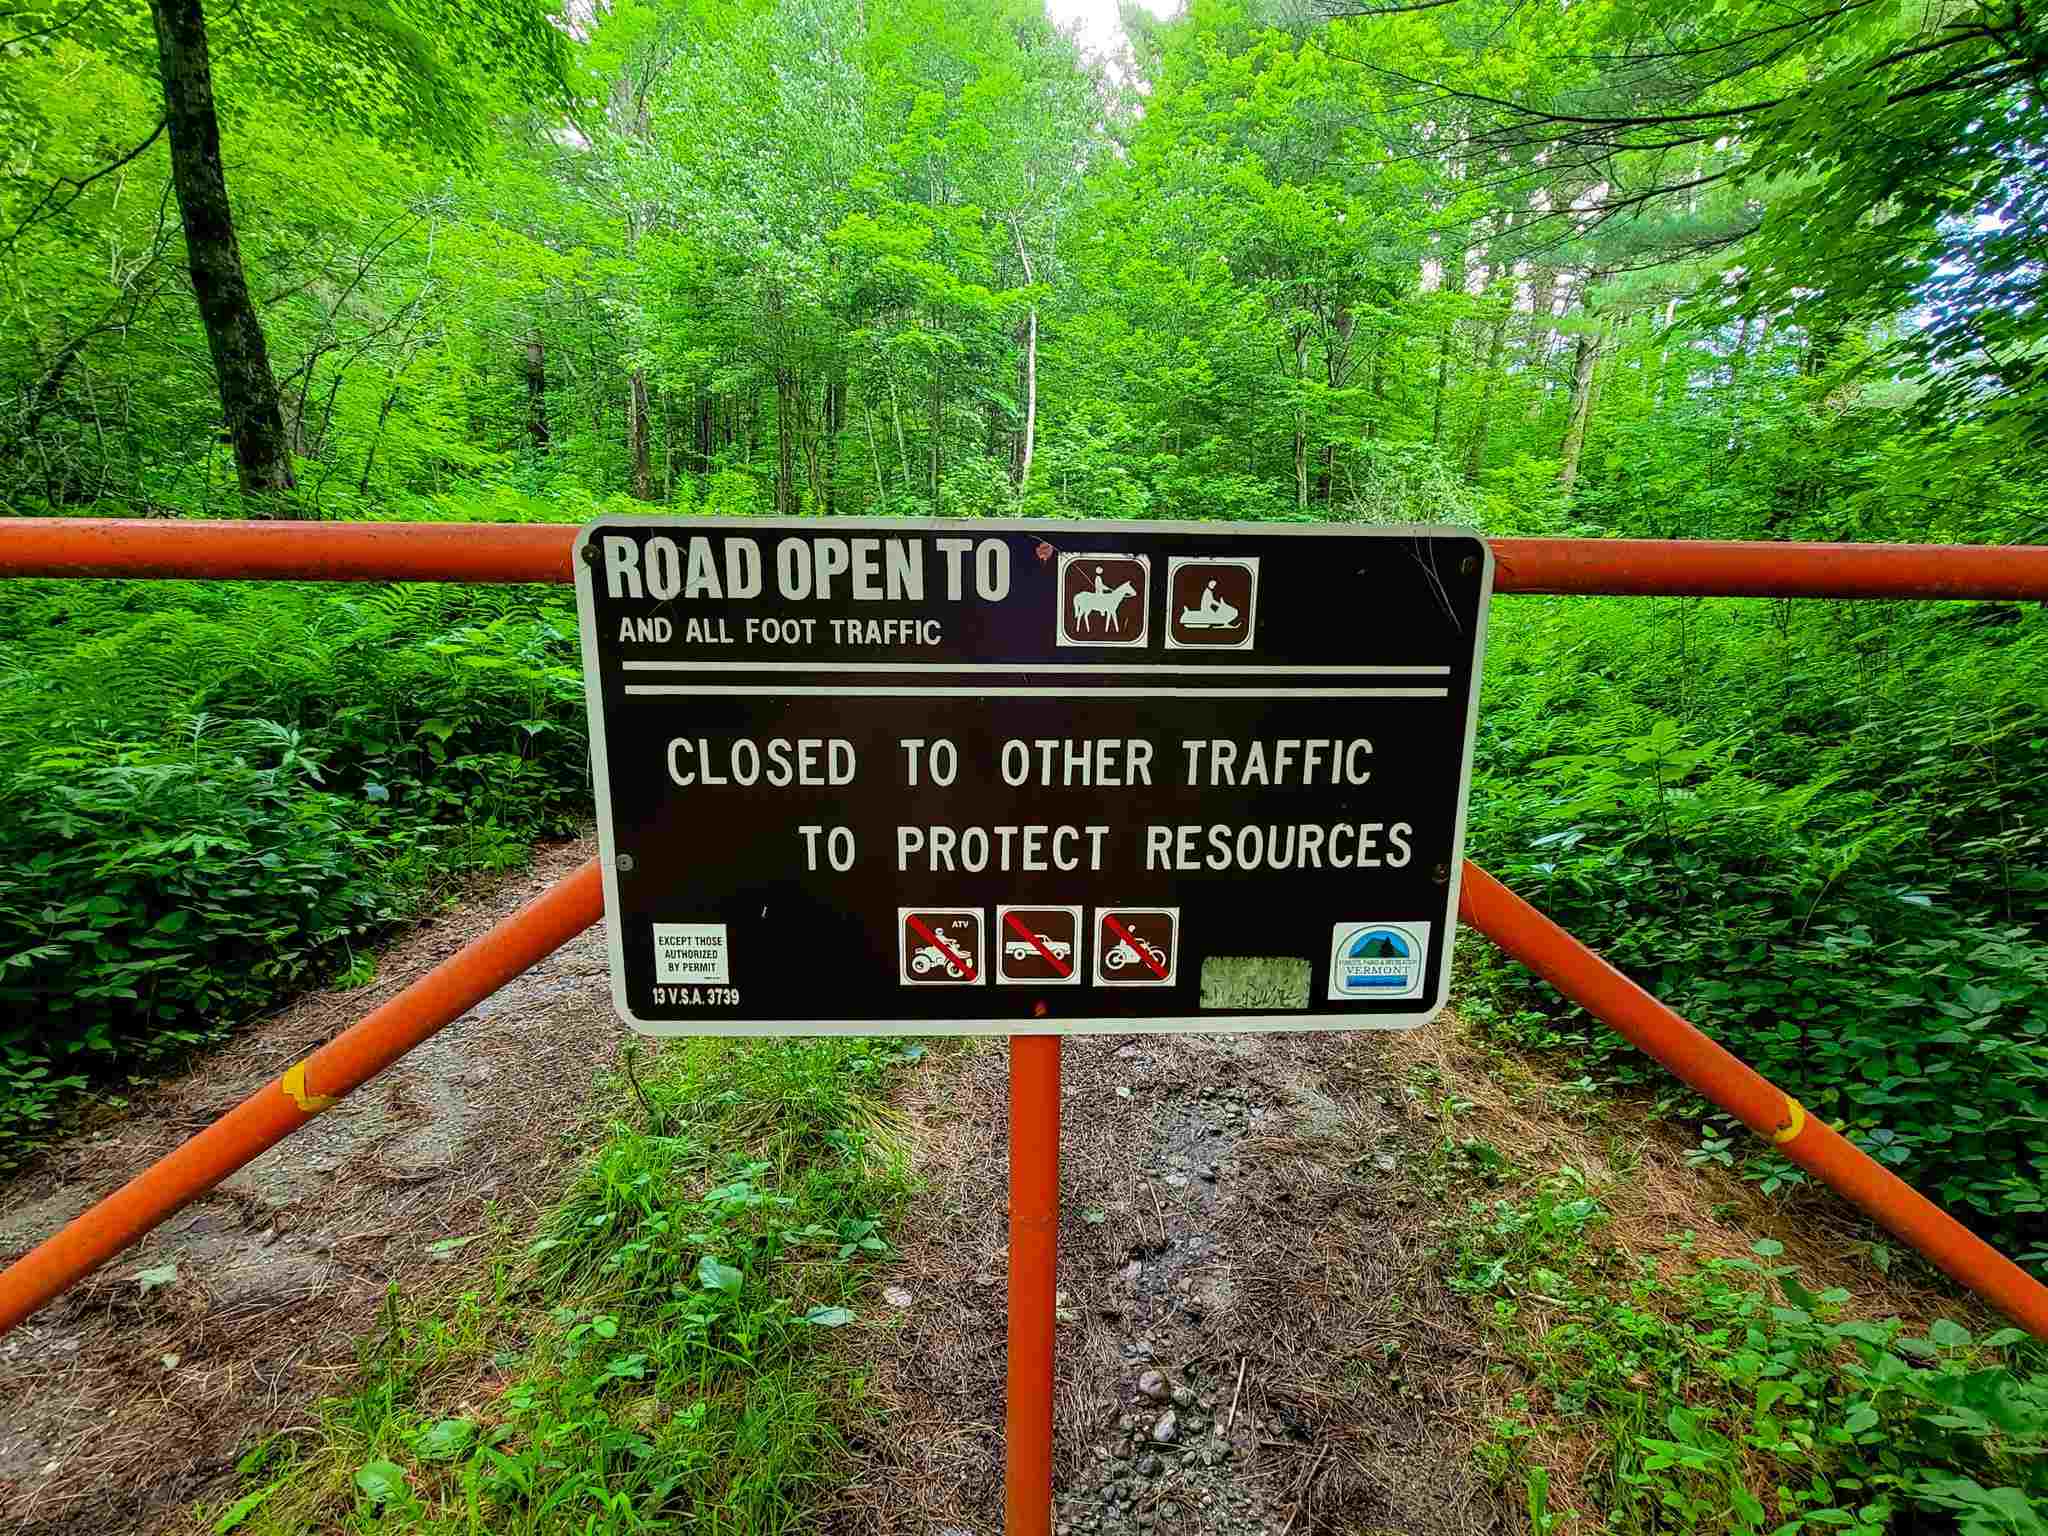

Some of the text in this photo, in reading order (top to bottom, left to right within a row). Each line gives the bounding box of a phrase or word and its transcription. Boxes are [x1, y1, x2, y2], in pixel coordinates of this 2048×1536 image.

[603, 536, 1011, 601] ROAD OPEN TO
[619, 617, 942, 645] AND ALL FOOT TRAFFIC
[667, 738, 1374, 787] CLOSED TO OTHER TRAFFIC
[798, 823, 1413, 872] TO PROTECT RESOURCES
[951, 920, 969, 929] ATV
[658, 936, 723, 946] EXCEPT THOSE
[664, 949, 718, 960] AUTHORIZED
[667, 962, 716, 973] BY PERMIT
[1344, 965, 1410, 976] VERMONT
[652, 987, 740, 1006] 13 V.S.A. 3739
